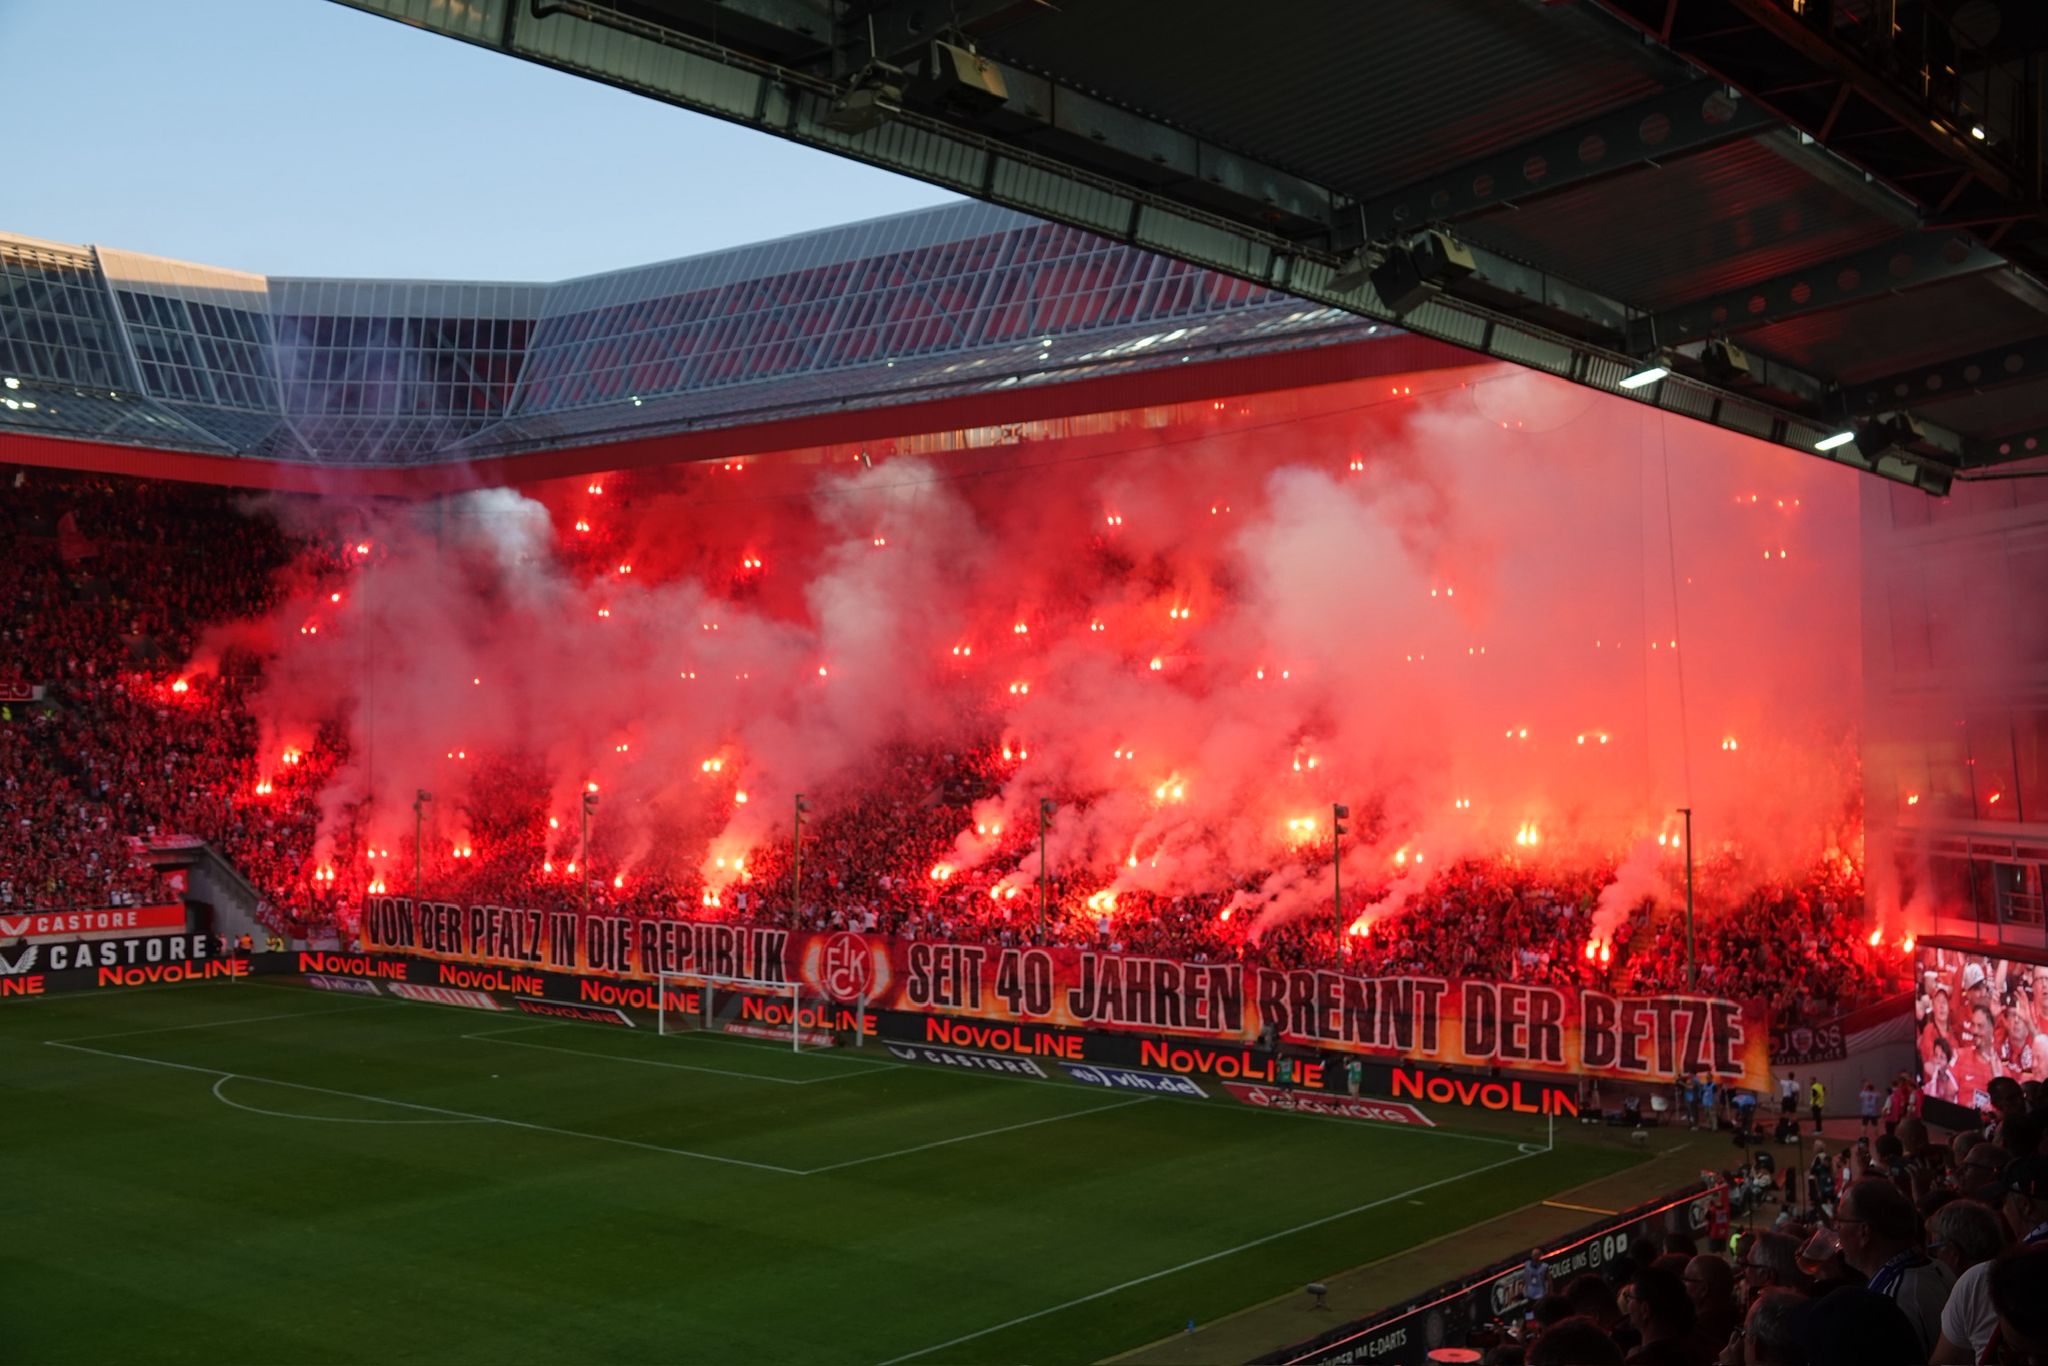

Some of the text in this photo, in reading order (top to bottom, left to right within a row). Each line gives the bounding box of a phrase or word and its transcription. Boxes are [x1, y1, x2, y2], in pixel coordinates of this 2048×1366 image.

[37, 911, 138, 933] CASTORE
[50, 934, 208, 970] CASTORE
[369, 896, 789, 989] VON DER PFALZ IN DIE REPUBLIK
[98, 959, 249, 987] NOVOLINE
[299, 951, 408, 981] NOVOLINE
[439, 963, 546, 998] NOVOLINE
[907, 943, 1745, 1078] SEIT 40 JAHREN BRENNT DER BETZE
[926, 1017, 1085, 1060] NOVOLINE
[924, 1050, 1037, 1075] CASTORE
[1112, 1072, 1196, 1095] vlh.de
[1369, 1327, 1408, 1358] E-DARTS
